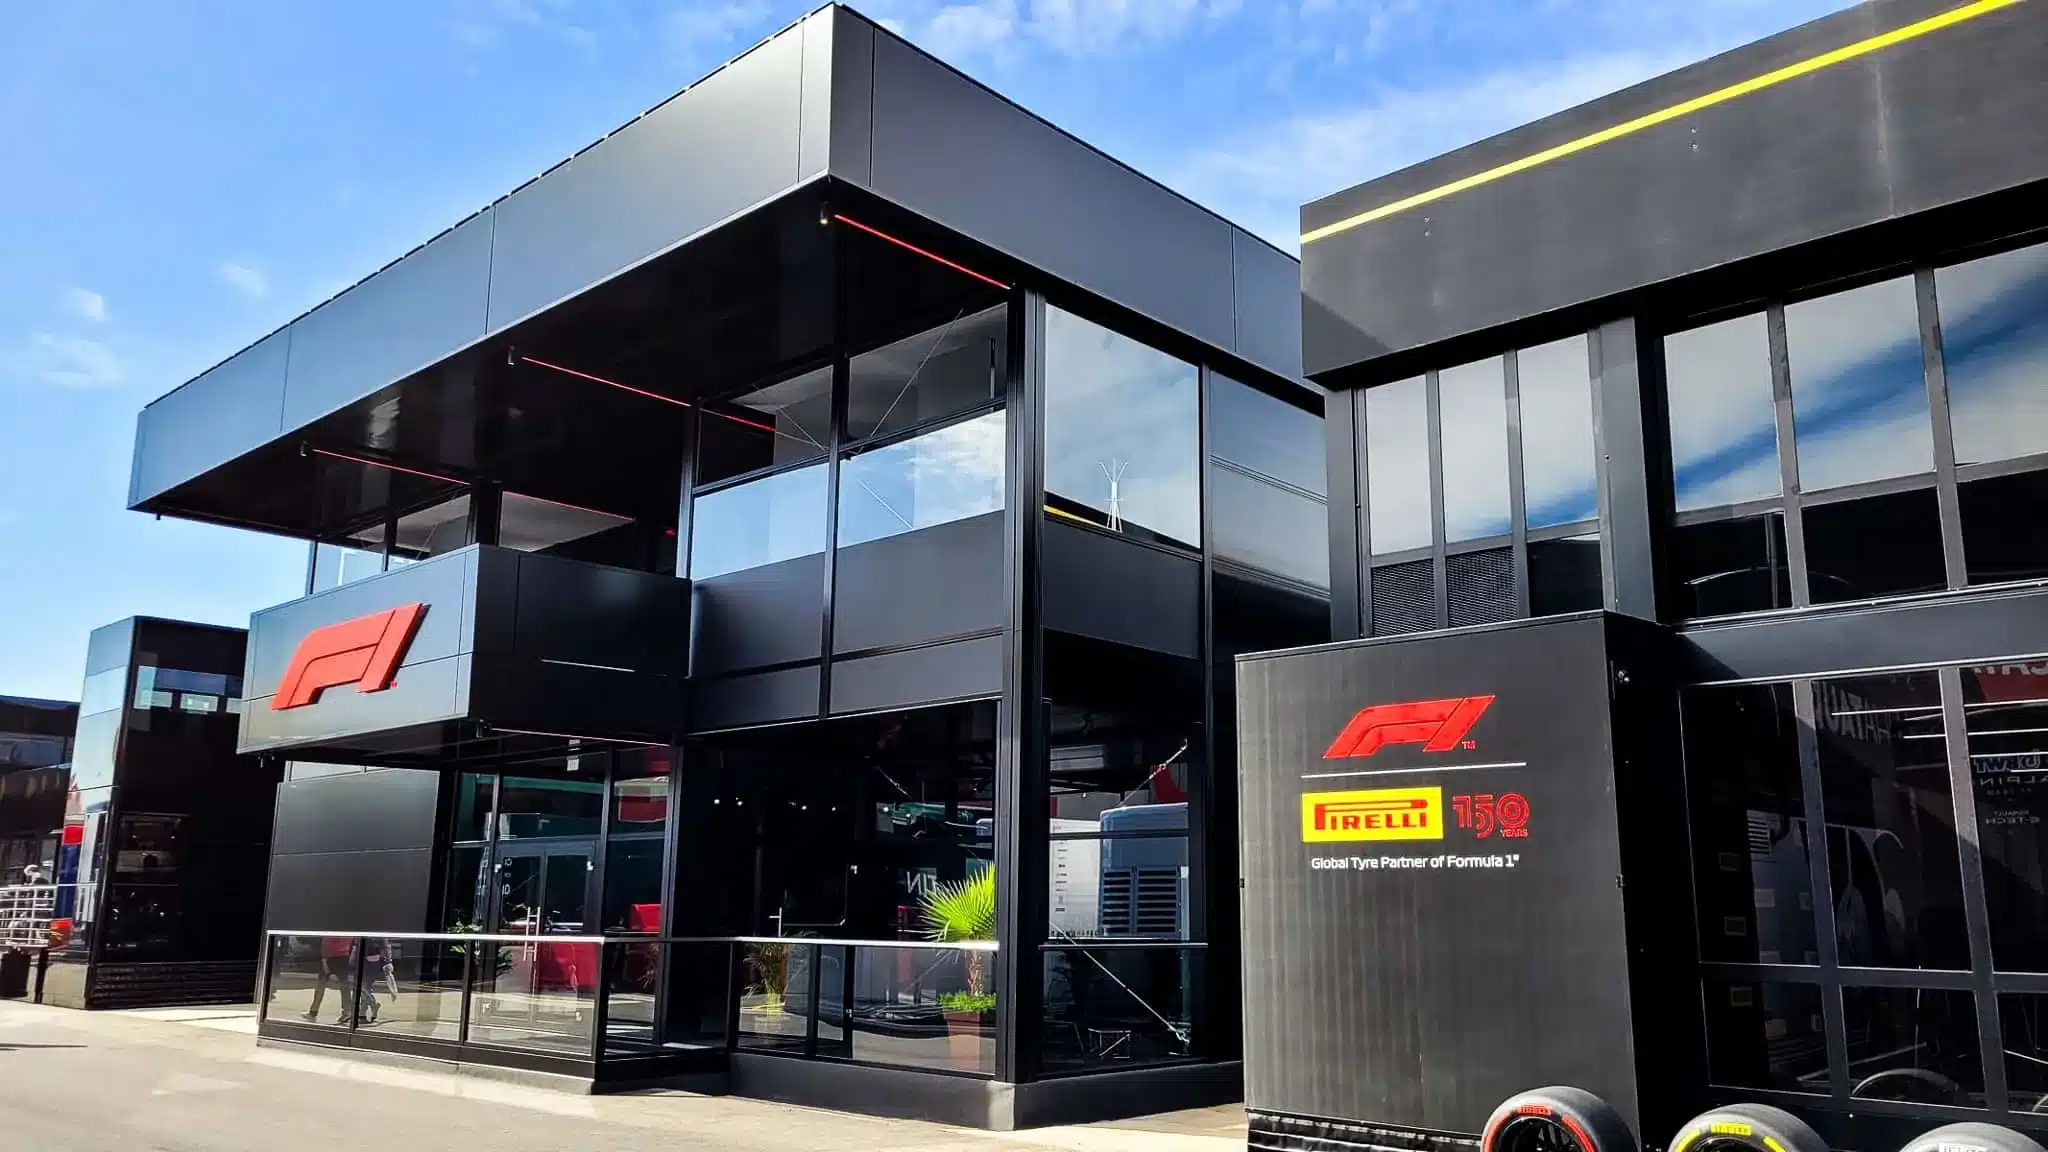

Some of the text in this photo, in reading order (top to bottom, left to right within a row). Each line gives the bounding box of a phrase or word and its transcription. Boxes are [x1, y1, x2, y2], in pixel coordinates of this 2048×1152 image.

[271, 602, 428, 710] F1
[1322, 694, 1496, 759] F1
[1314, 799, 1428, 831] PIRELLI
[1452, 793, 1530, 839] 150
[1500, 828, 1529, 837] YEARS
[1311, 856, 1349, 870] Global
[1350, 856, 1379, 871] Tyre
[1380, 855, 1429, 869] Partner
[1430, 855, 1445, 868] of
[1447, 854, 1504, 868] Formula
